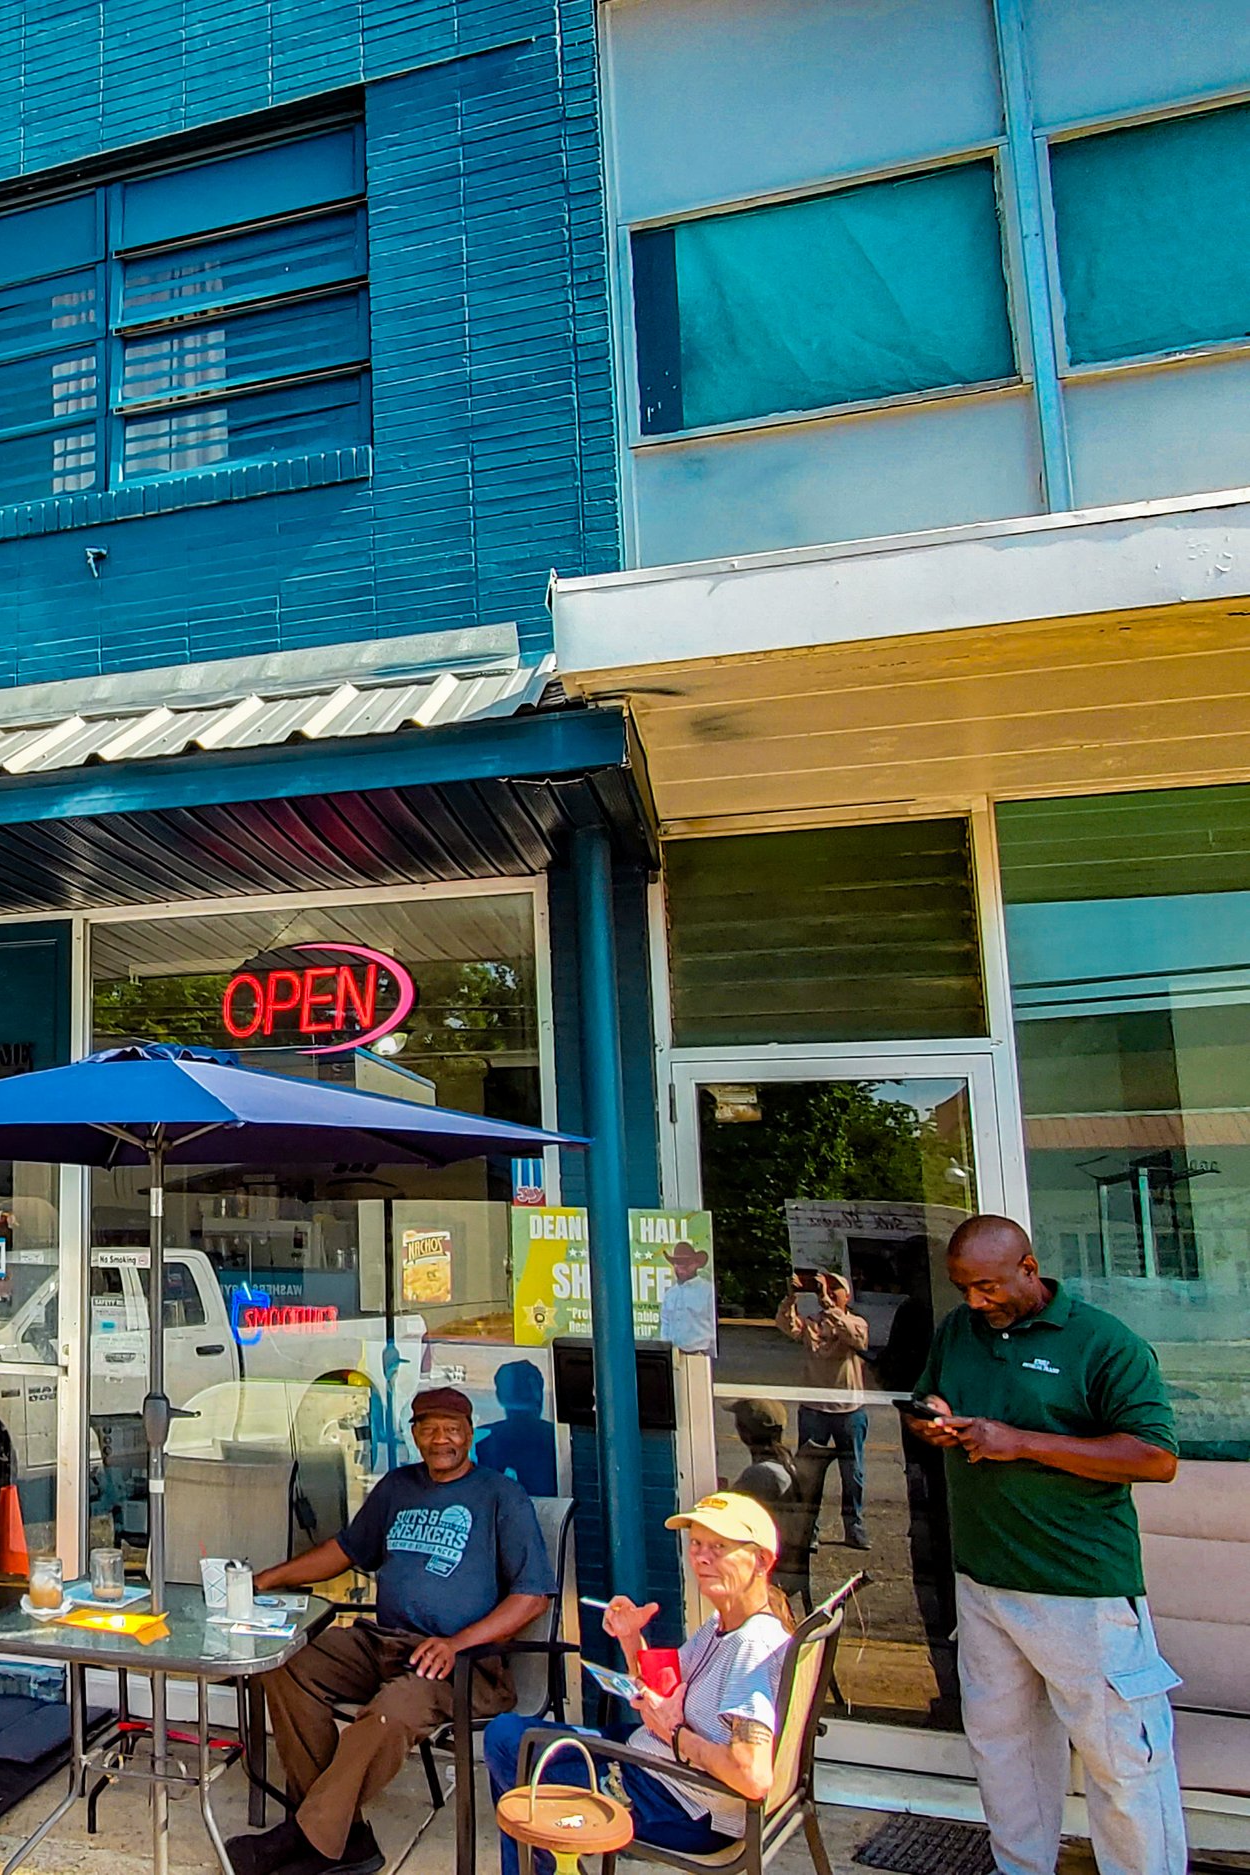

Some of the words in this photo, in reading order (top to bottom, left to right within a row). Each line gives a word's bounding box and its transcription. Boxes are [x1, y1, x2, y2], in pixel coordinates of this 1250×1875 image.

[223, 964, 377, 1038] OPEN
[529, 1215, 589, 1240] DEAN
[640, 1218, 692, 1244] HALL
[100, 1255, 109, 1263] No
[109, 1255, 137, 1265] Smoking
[406, 1236, 447, 1264] NACHOS
[552, 1263, 672, 1302] SHIFF
[387, 1521, 469, 1550] SNEAKERS
